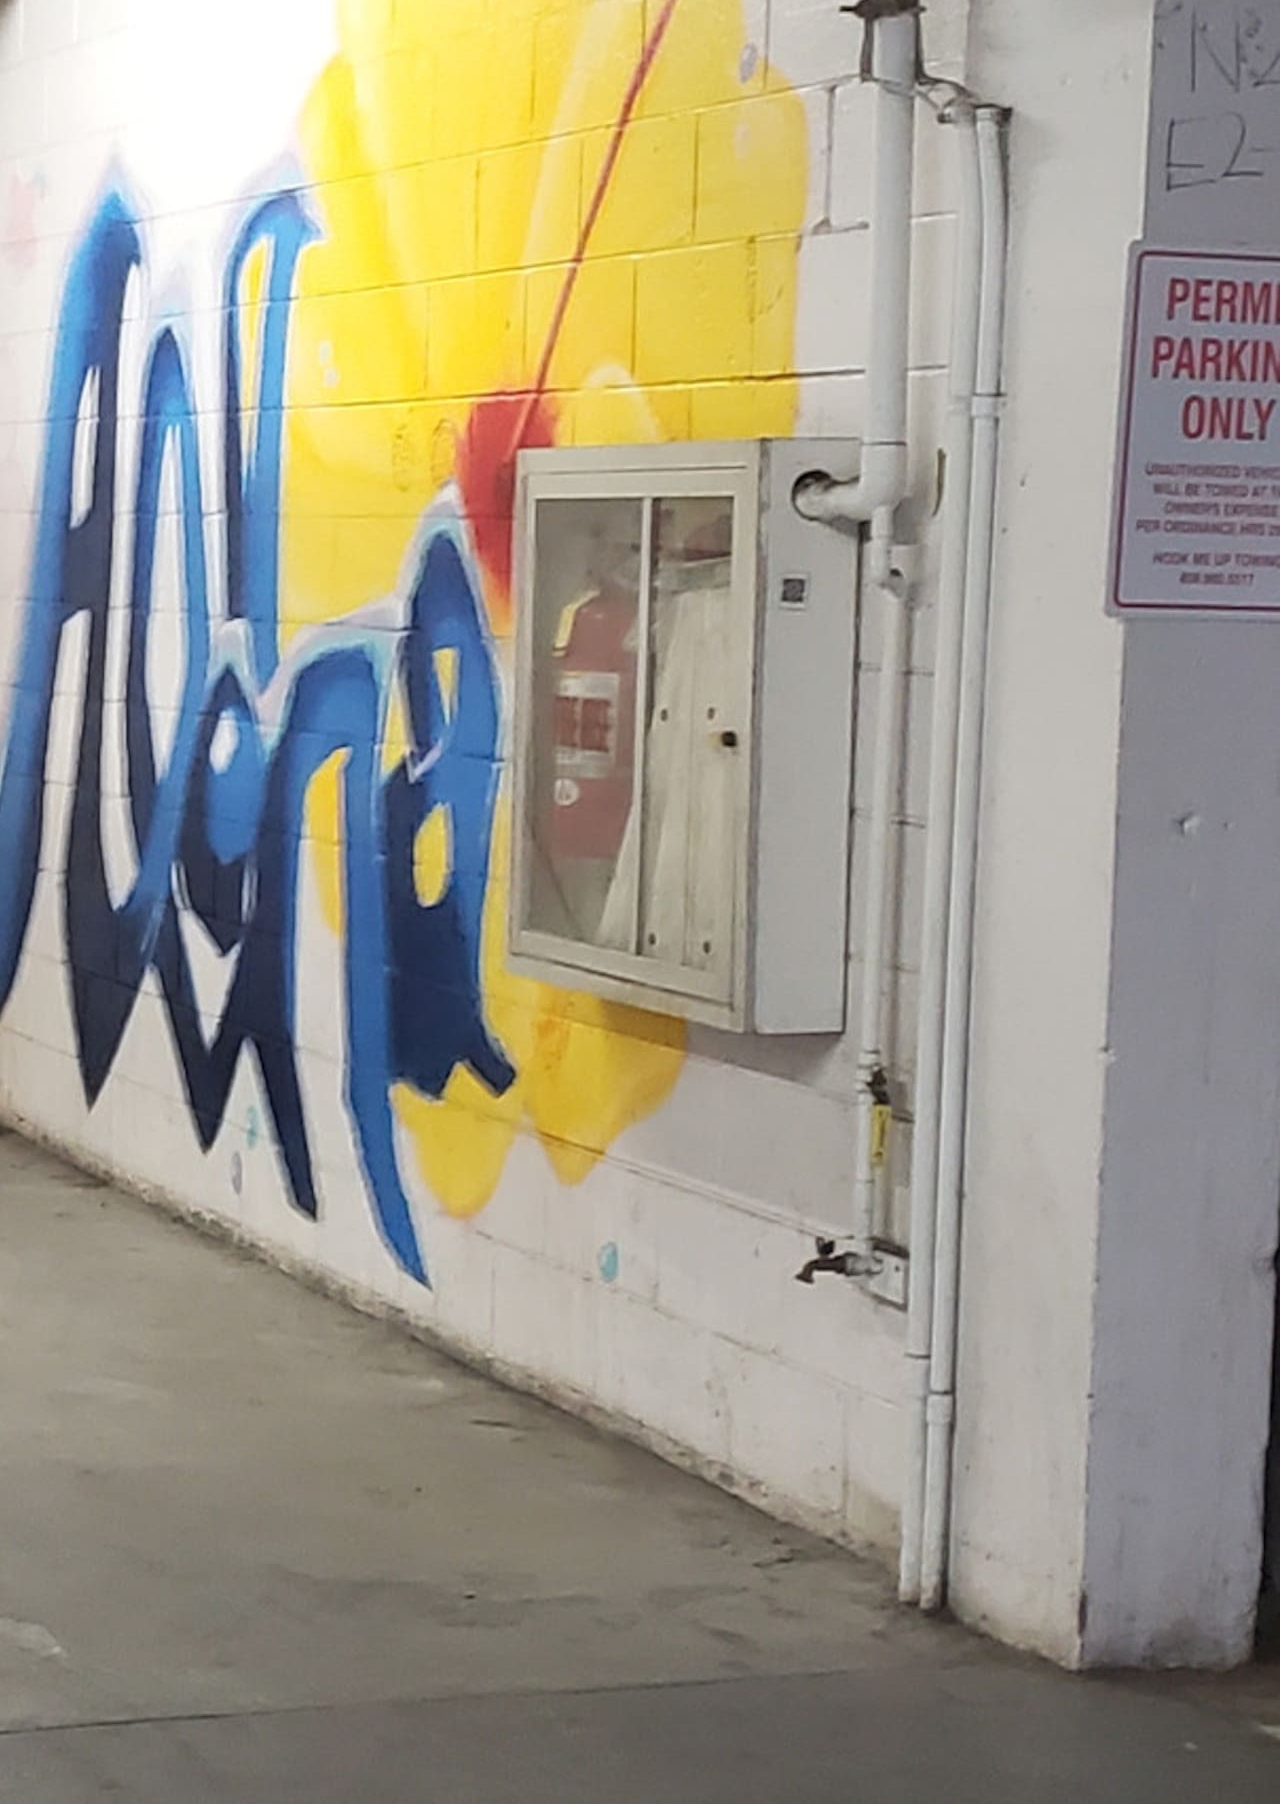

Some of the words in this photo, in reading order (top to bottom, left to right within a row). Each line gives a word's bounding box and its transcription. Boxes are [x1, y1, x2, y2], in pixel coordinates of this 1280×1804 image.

[1182, 394, 1276, 441] ONLY
[1183, 483, 1200, 496] BE
[1204, 483, 1249, 498] TOWED
